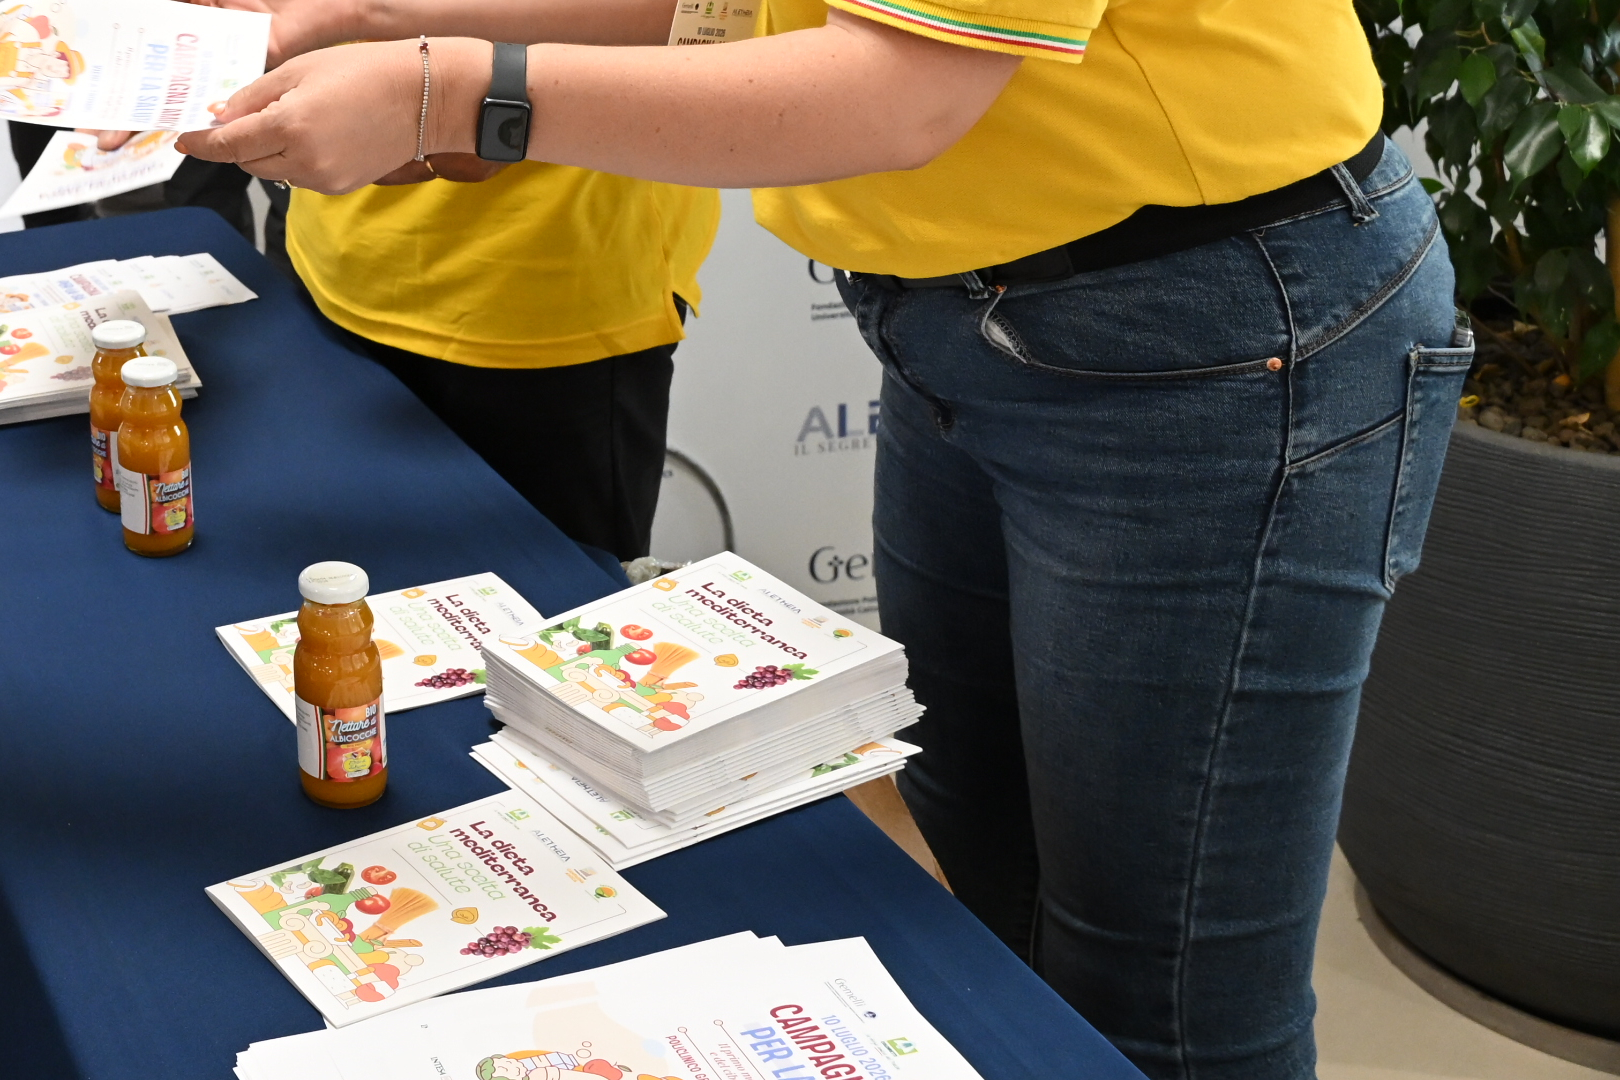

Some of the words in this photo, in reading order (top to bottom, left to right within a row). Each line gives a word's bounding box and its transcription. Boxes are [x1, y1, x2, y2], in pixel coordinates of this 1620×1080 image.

[145, 42, 171, 72] PER
[140, 76, 163, 92] LA
[445, 594, 464, 608] La
[460, 607, 491, 635] dieta
[668, 594, 706, 618] Una
[702, 617, 757, 648] scelta
[701, 582, 726, 599] La
[726, 598, 774, 627] dieta
[758, 587, 802, 615] ALETHEIA
[400, 614, 435, 645] salute
[408, 602, 433, 621] Una
[427, 622, 462, 651] scelta
[427, 598, 482, 651] mediterra
[651, 601, 673, 613] di
[669, 612, 724, 645] salute
[684, 588, 808, 660] mediterranea
[328, 718, 369, 735] Nettare
[365, 704, 377, 717] BIO
[330, 727, 377, 742] ALBICOCCHE
[469, 820, 494, 840] La
[491, 838, 535, 877] dieta
[531, 829, 571, 863] ALETHEIA
[407, 841, 433, 854] di
[422, 854, 471, 894] salute
[428, 834, 463, 860] Una
[457, 861, 506, 901] scelta
[449, 828, 557, 923] mediterranea
[834, 977, 866, 1007] Gemelli
[665, 1035, 702, 1073] POLICLINICO
[740, 1026, 793, 1063] PER
[770, 1004, 864, 1080] CAMPAG
[821, 1014, 841, 1026] 10
[831, 1026, 869, 1057] LUGLIO
